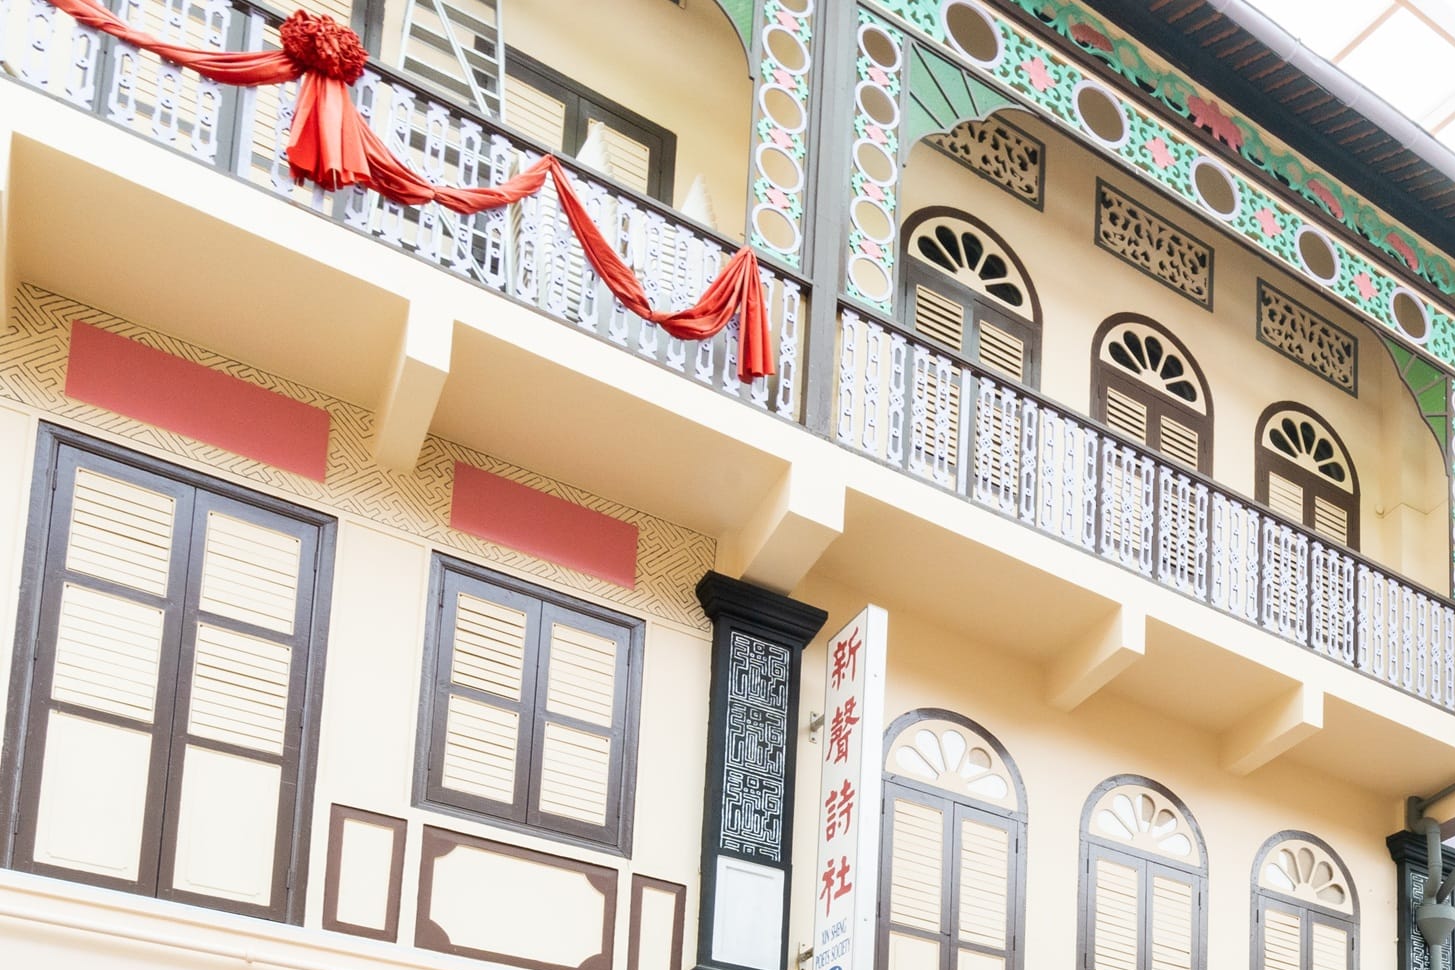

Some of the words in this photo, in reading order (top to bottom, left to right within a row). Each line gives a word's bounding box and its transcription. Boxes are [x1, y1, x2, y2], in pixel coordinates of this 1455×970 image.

[820, 626, 862, 918] 新聲詩社
[821, 931, 830, 946] XIN
[831, 918, 847, 942] SHENG
[815, 948, 831, 970] POETS
[831, 937, 850, 963] SOCIETY
